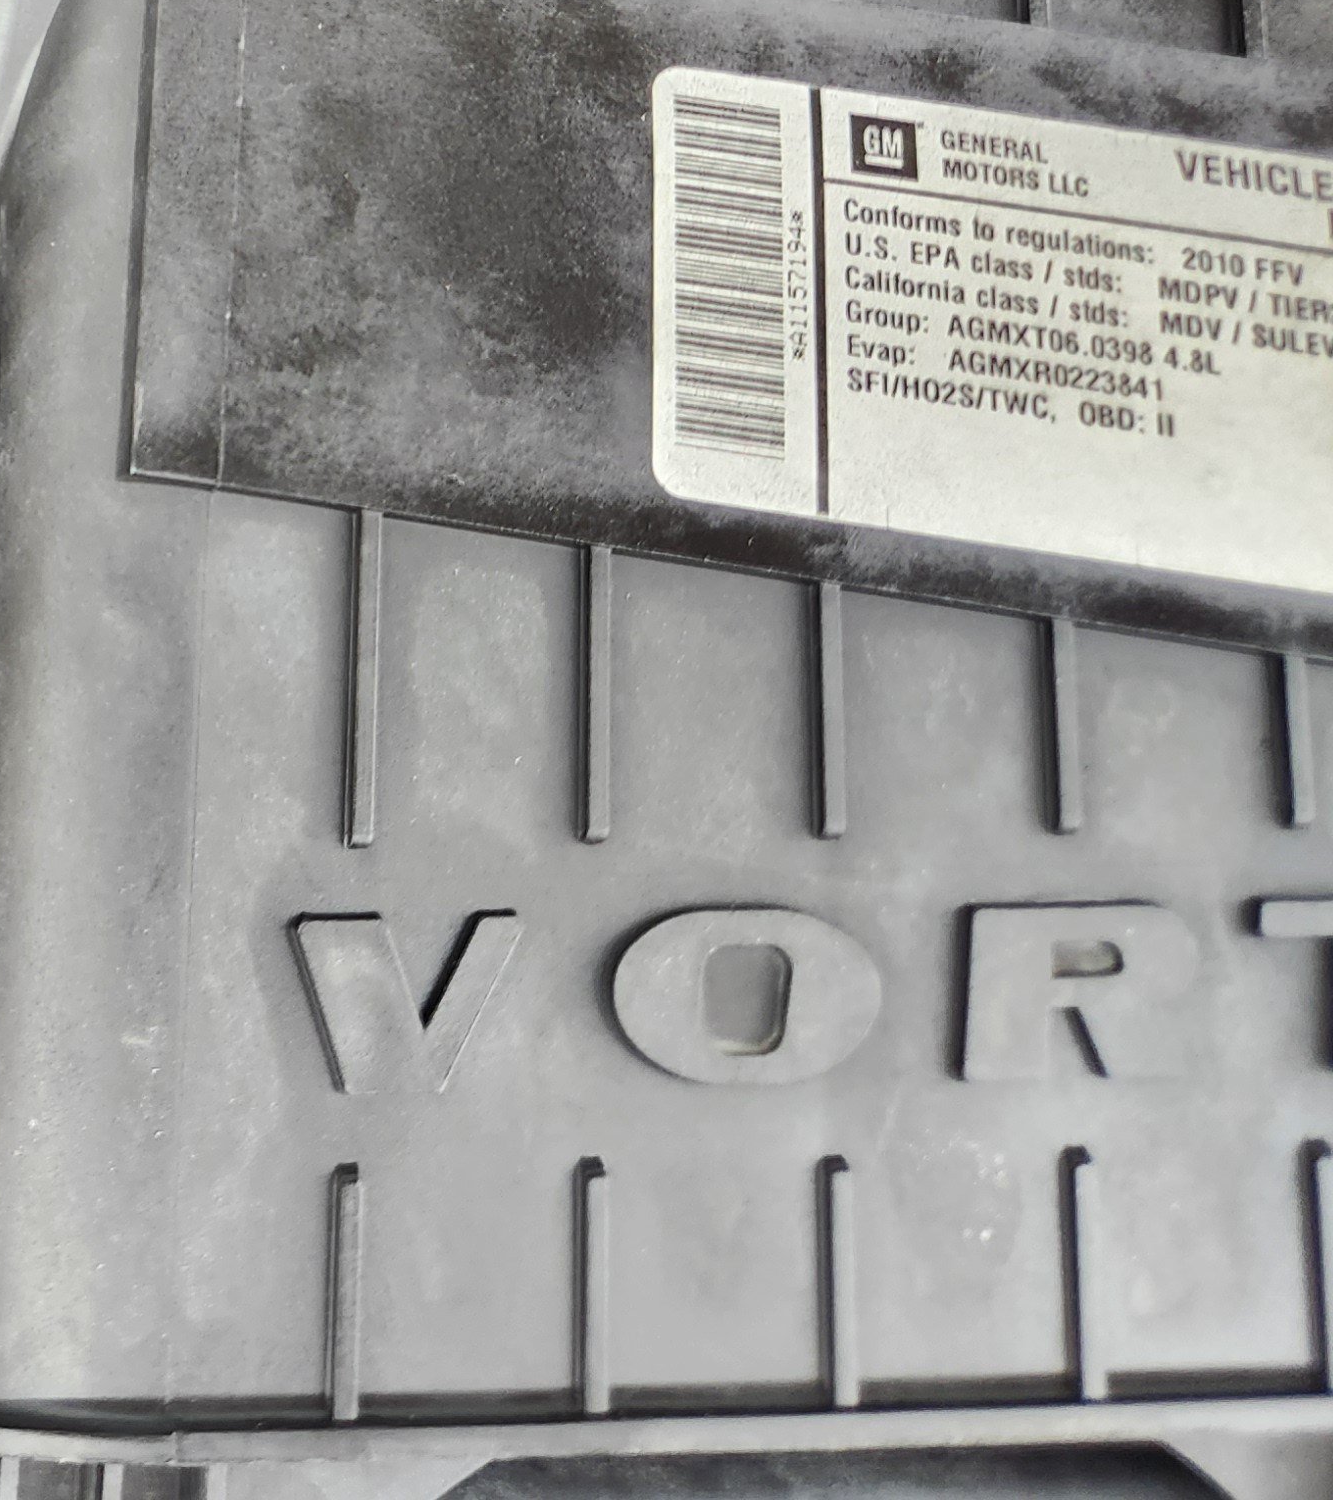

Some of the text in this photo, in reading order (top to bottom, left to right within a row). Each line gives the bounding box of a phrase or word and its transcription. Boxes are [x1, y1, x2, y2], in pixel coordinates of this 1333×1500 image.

[940, 130, 1048, 164] GENERAL
[942, 158, 1089, 197] MOTORS LLC
[1175, 150, 1333, 202] VEHICLE
[844, 199, 1304, 286] Conforms to regulations: 2010 FFV
[845, 232, 897, 261] U.S.
[910, 241, 959, 270] EPA
[971, 251, 1033, 281] class
[1043, 259, 1053, 284] /
[1063, 266, 1123, 294] stds:
[1158, 276, 1238, 310] MDPV
[1248, 290, 1258, 314] /
[845, 265, 965, 305] California
[976, 285, 1039, 316] class
[1049, 294, 1058, 319] /
[1069, 301, 1129, 328] stds:
[1159, 310, 1222, 341] MDV
[1232, 321, 1241, 345] /
[845, 300, 1221, 376] Group: AGMXT06.0398 4.8L
[846, 334, 1164, 402] Evap: AGMXR0223841
[847, 367, 1175, 438] SFI/HO2S/TWC, OBD: II
